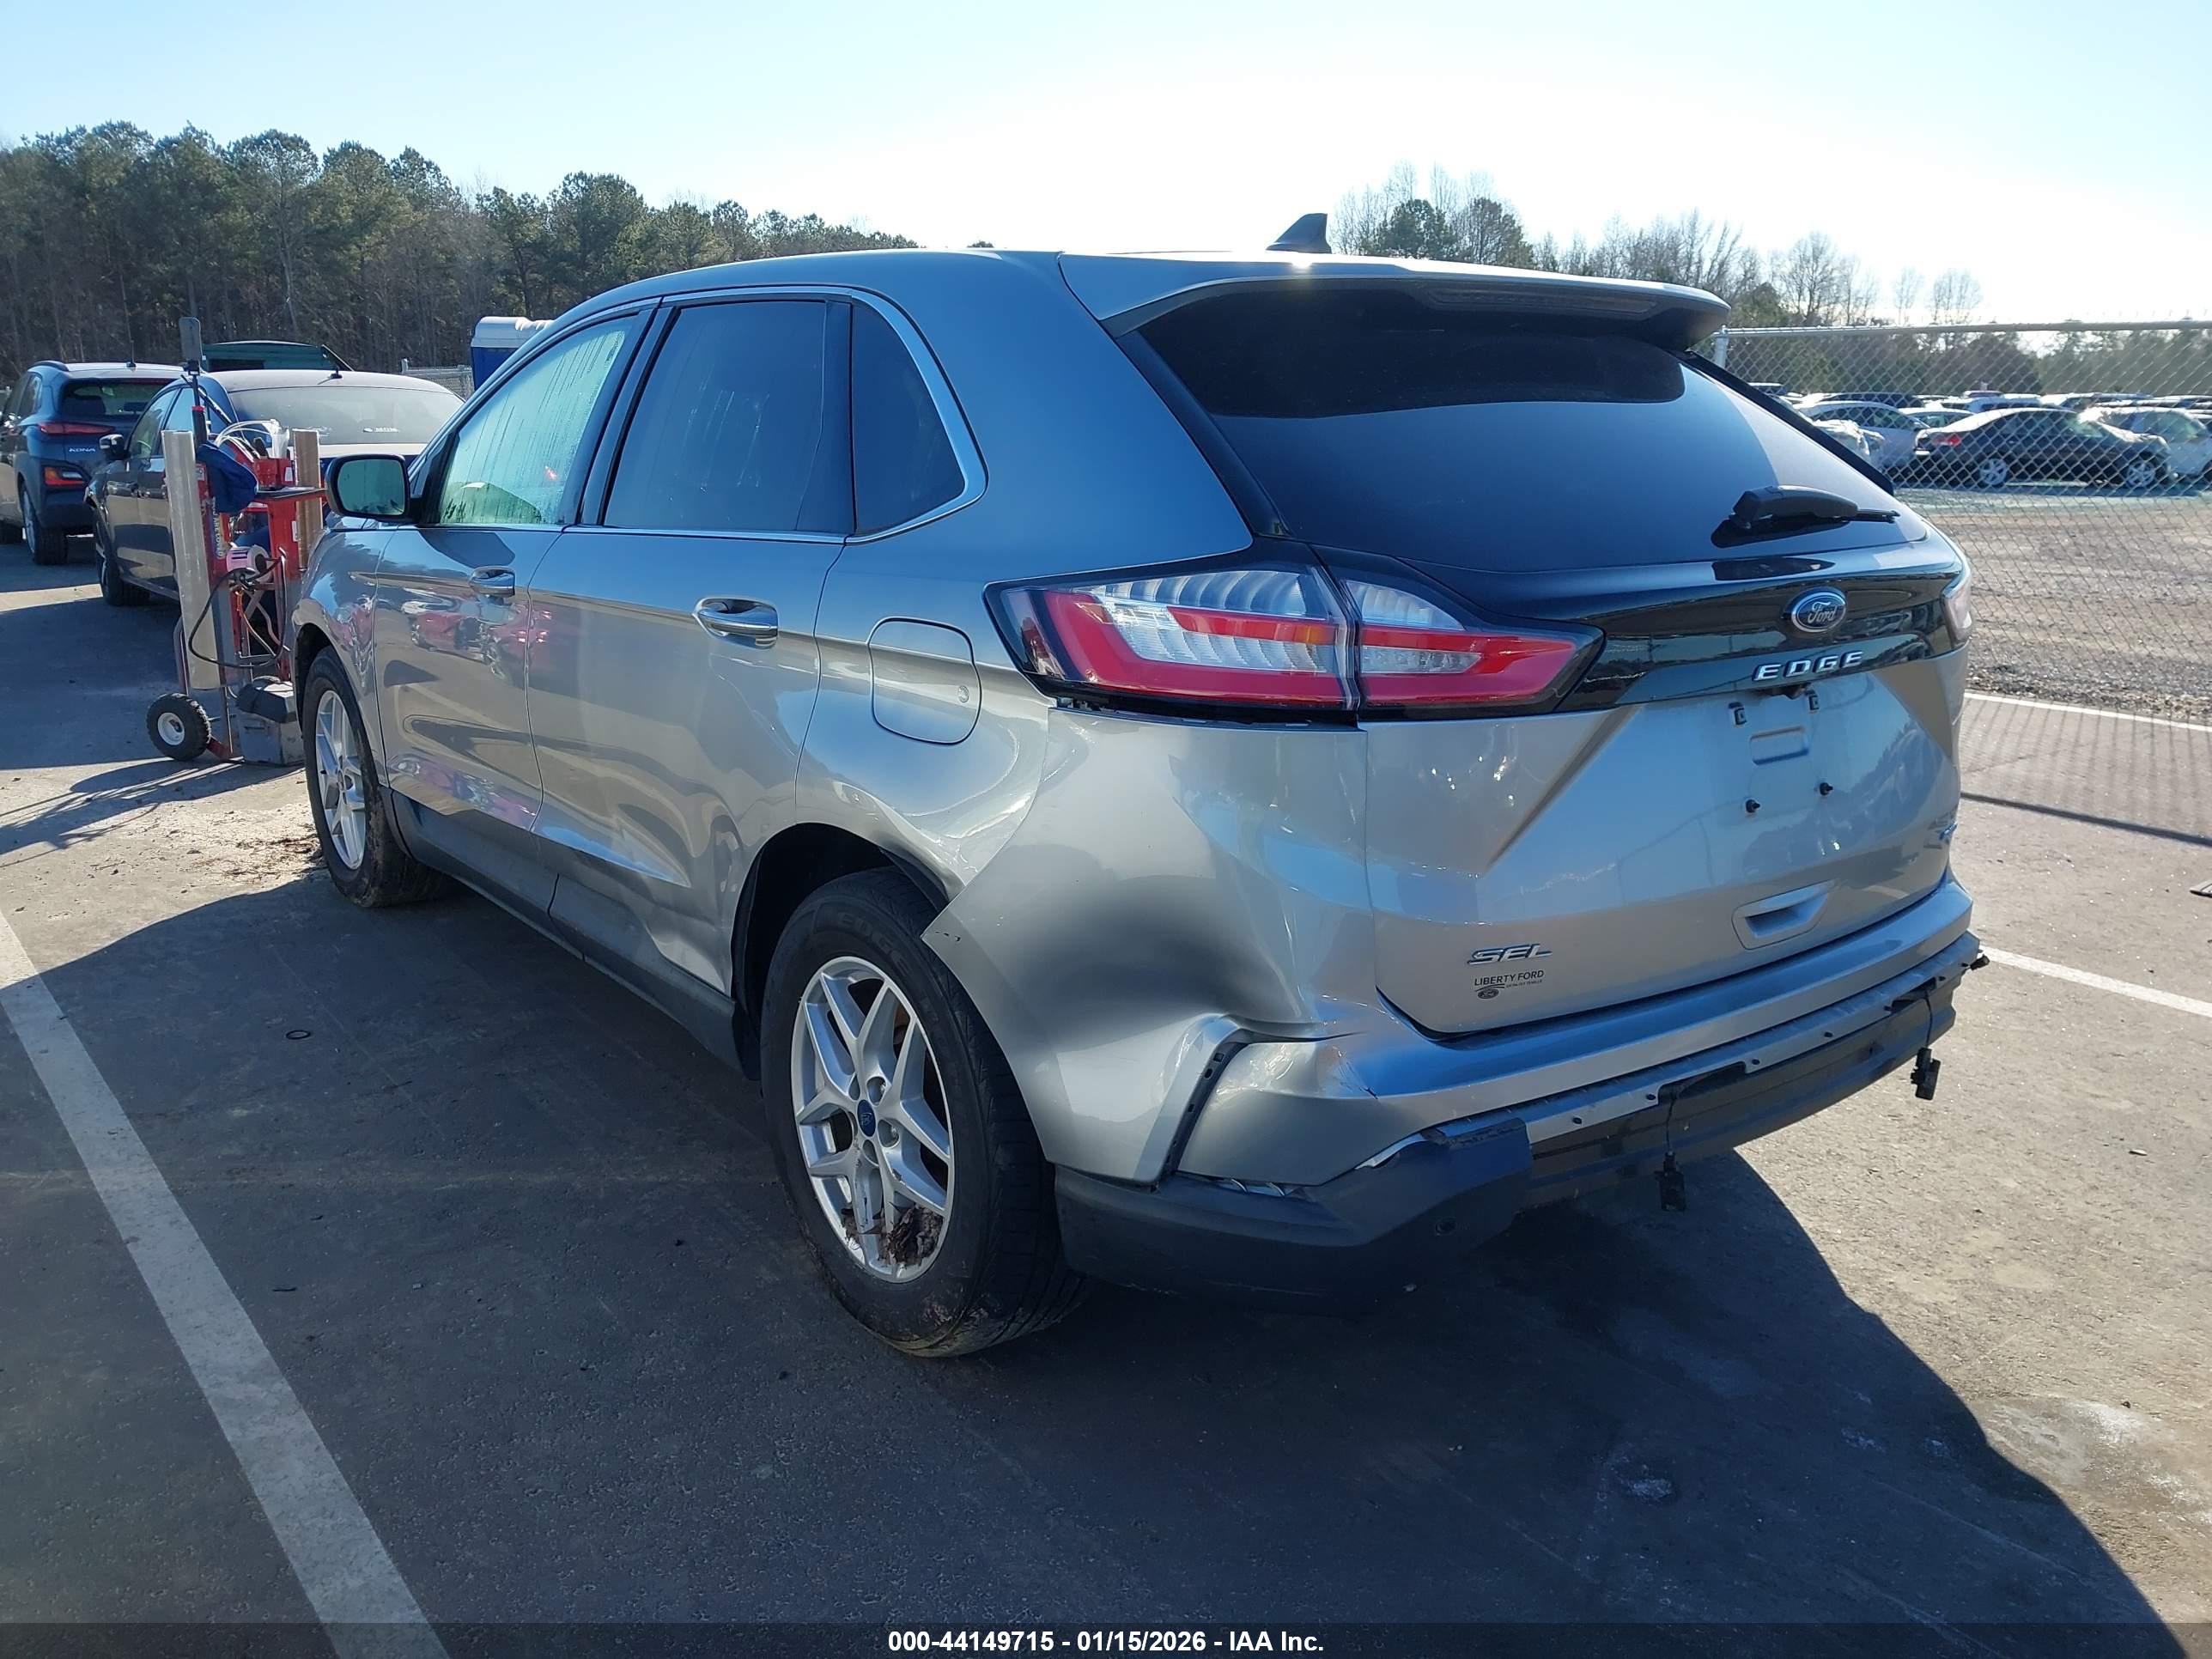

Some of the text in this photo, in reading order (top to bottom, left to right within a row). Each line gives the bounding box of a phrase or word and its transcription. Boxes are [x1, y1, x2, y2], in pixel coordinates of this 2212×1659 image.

[1807, 600, 1838, 624] Ford
[1753, 650, 1863, 681] EDGE
[1468, 943, 1553, 966] SEL
[1474, 973, 1517, 987] LIBERTY
[1517, 969, 1545, 981] FORD
